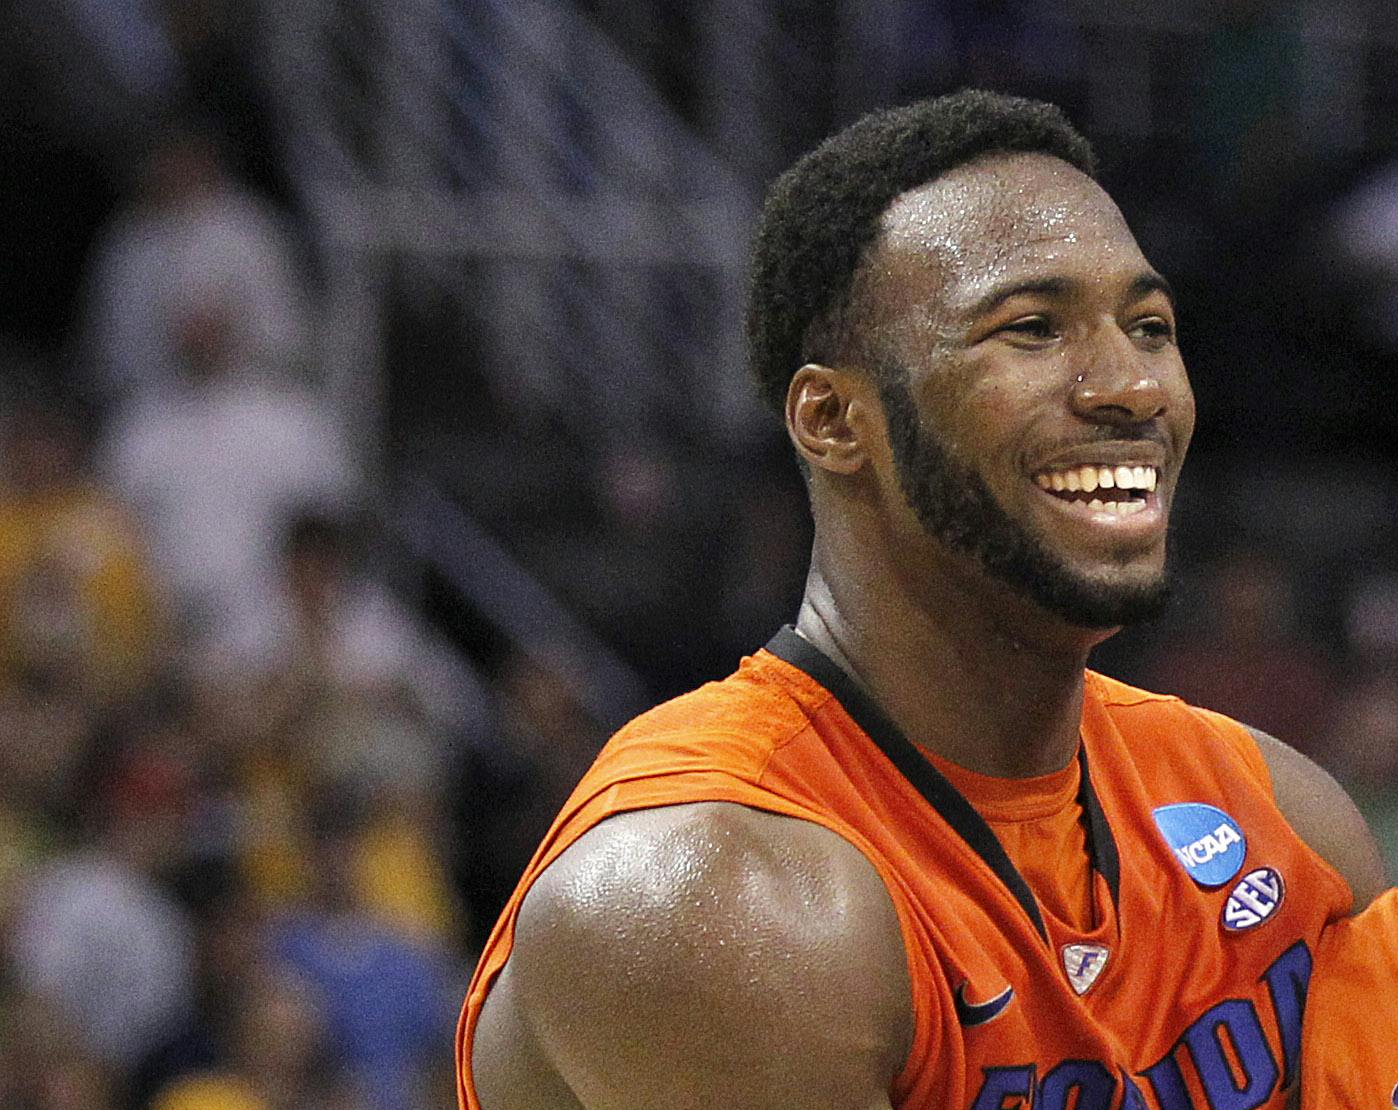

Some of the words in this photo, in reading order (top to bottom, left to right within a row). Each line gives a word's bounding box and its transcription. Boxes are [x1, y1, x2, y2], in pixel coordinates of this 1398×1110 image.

[1174, 822, 1241, 868] NCAA
[1225, 869, 1280, 928] SEC
[1076, 952, 1100, 977] F
